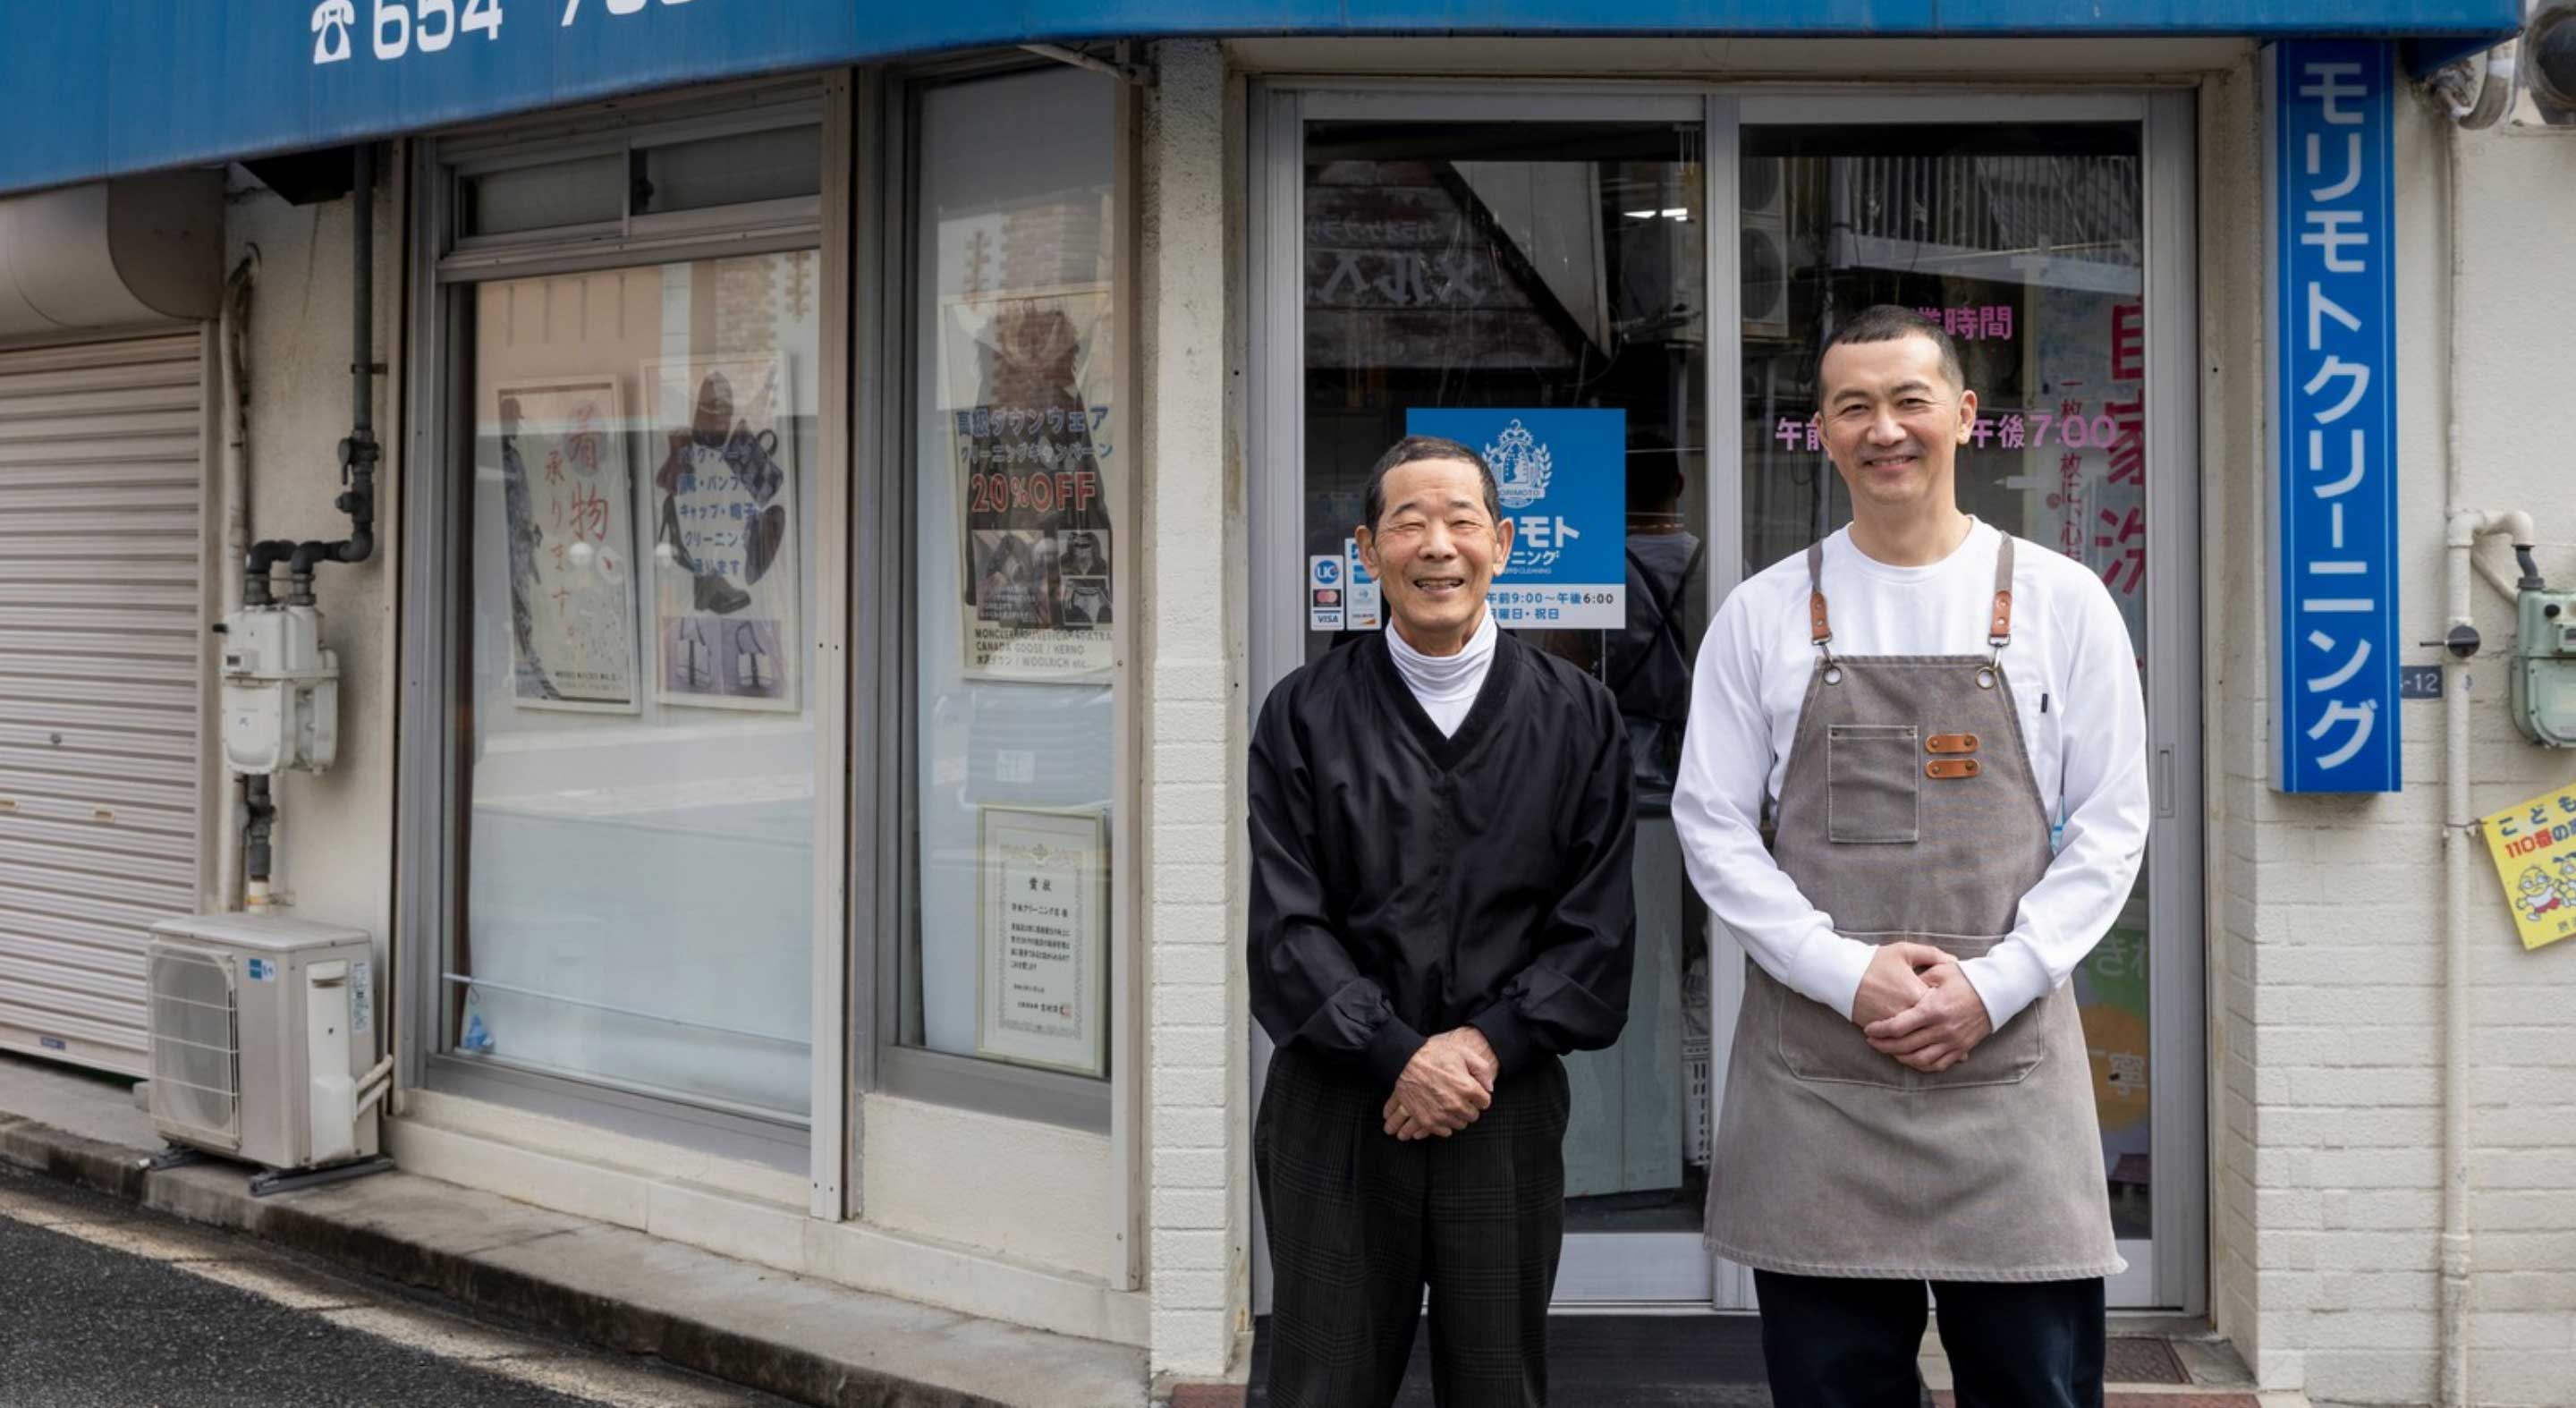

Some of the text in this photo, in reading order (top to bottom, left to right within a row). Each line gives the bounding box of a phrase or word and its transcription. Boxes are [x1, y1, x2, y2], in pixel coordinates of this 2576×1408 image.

[2299, 63, 2379, 770] モリモトクリーニング
[971, 471, 1096, 513] 20%OFF
[1318, 565, 1340, 579] UC
[1317, 615, 1338, 623] VISA
[2400, 673, 2438, 691] -12
[2505, 817, 2576, 859] 110番の
